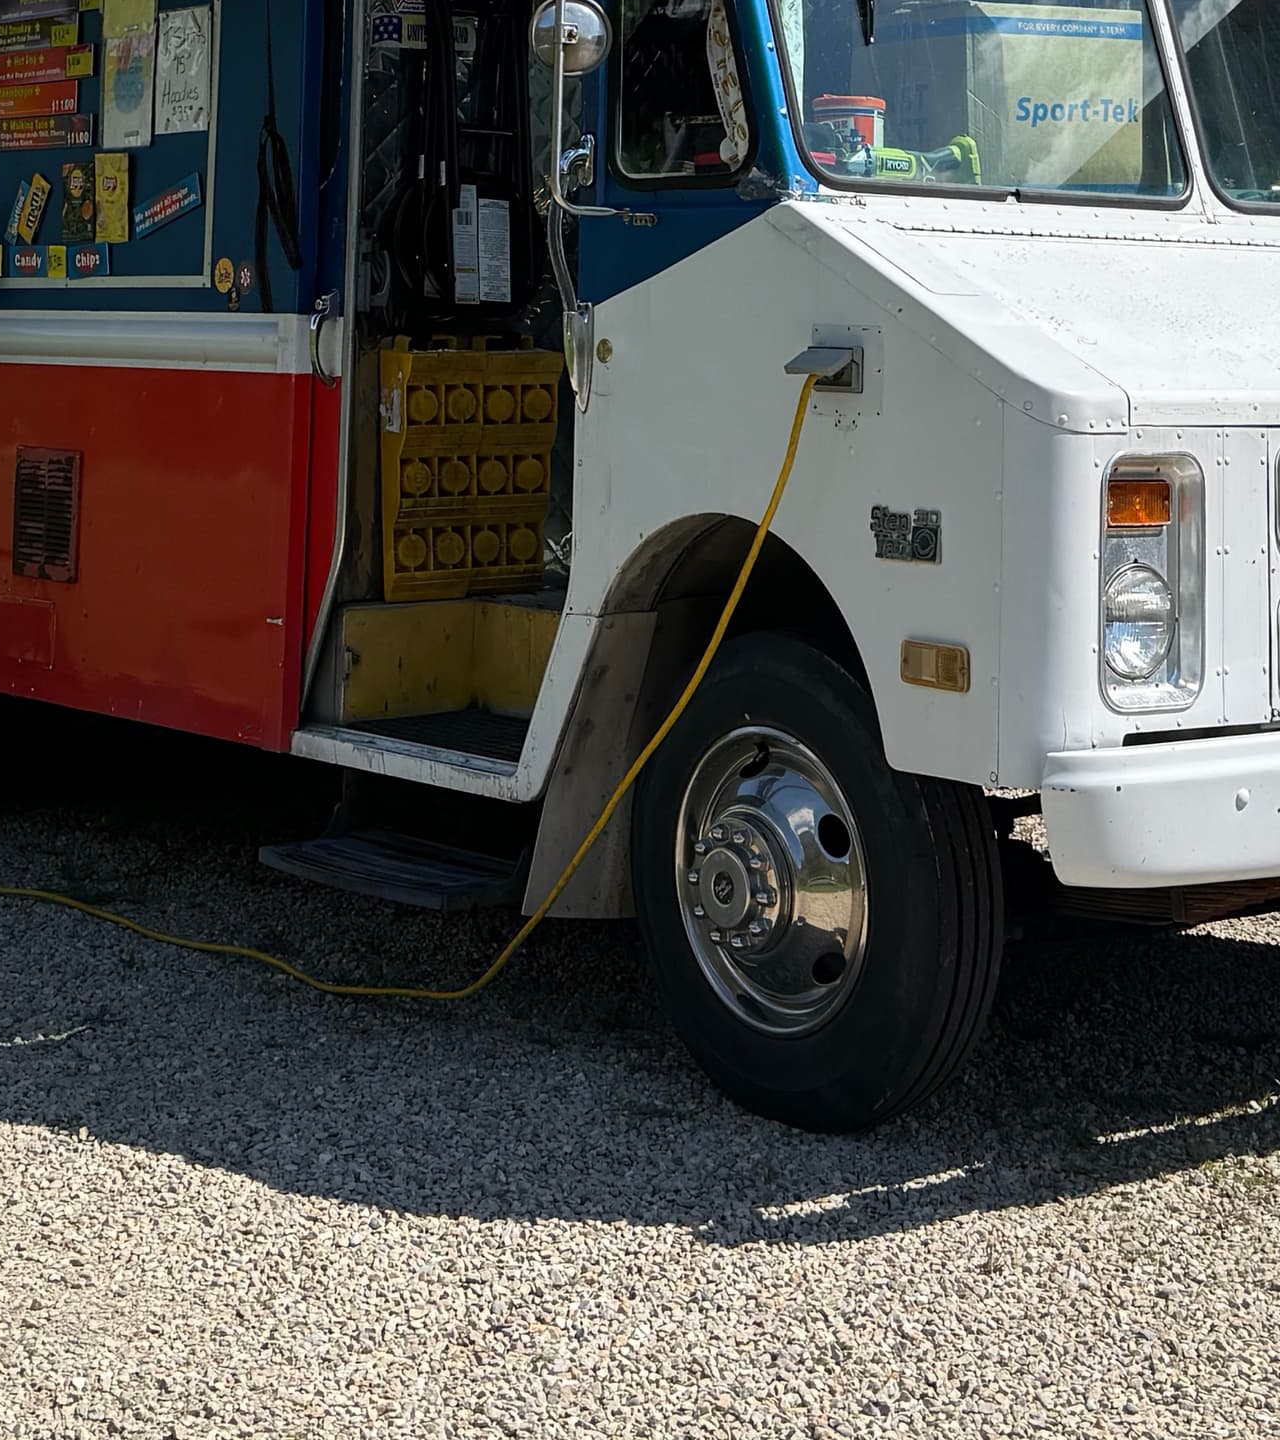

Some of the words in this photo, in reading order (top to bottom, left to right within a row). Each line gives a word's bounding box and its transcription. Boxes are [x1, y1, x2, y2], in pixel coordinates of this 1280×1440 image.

[1018, 21, 1034, 32] FOR
[1035, 22, 1060, 33] EVERY
[1061, 23, 1097, 34] COMPANY
[1105, 25, 1126, 35] TEAM
[162, 80, 199, 105] Hoodies
[52, 98, 75, 112] $11.00
[1016, 96, 1139, 128] Sport-Tek
[9, 120, 33, 130] Walking
[67, 131, 89, 145] $11.00
[15, 253, 42, 269] Candy
[75, 253, 100, 268] Chips
